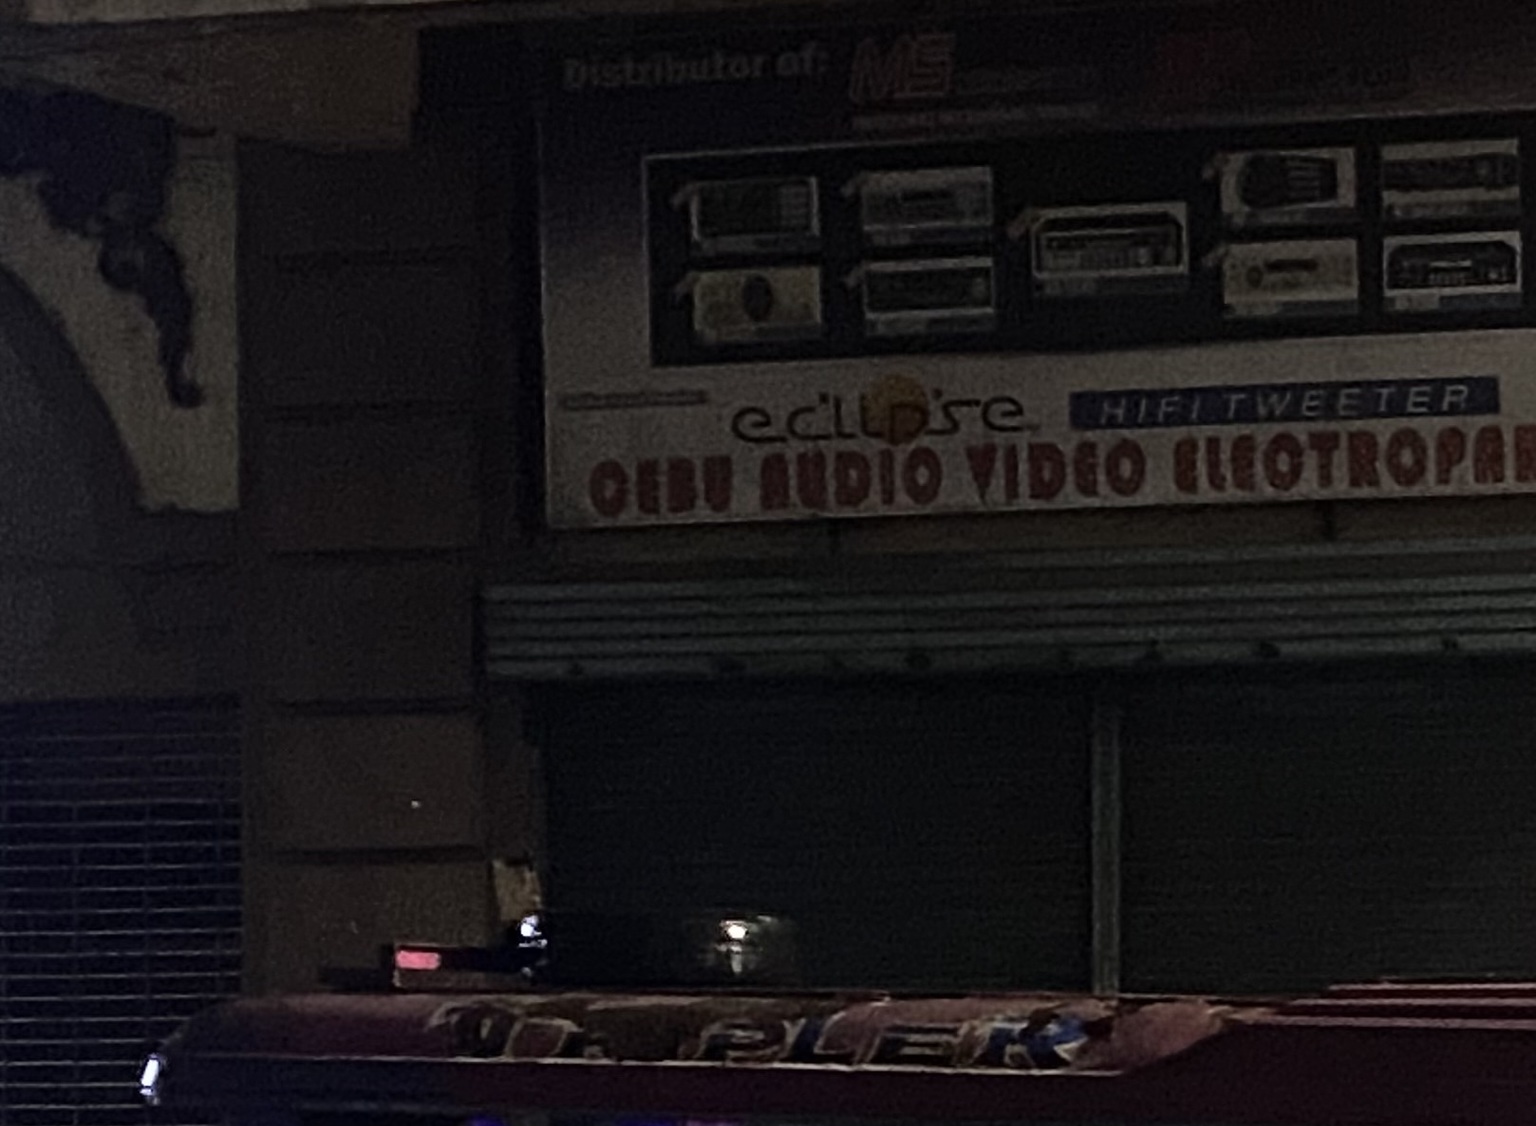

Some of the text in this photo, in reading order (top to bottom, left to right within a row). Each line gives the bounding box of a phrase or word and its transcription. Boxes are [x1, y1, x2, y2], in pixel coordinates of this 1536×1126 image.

[564, 50, 763, 89] Distributor
[1099, 383, 1472, 426] HIFI TWEETER
[760, 447, 942, 509] AUDIO
[966, 438, 1146, 501] VIDEO
